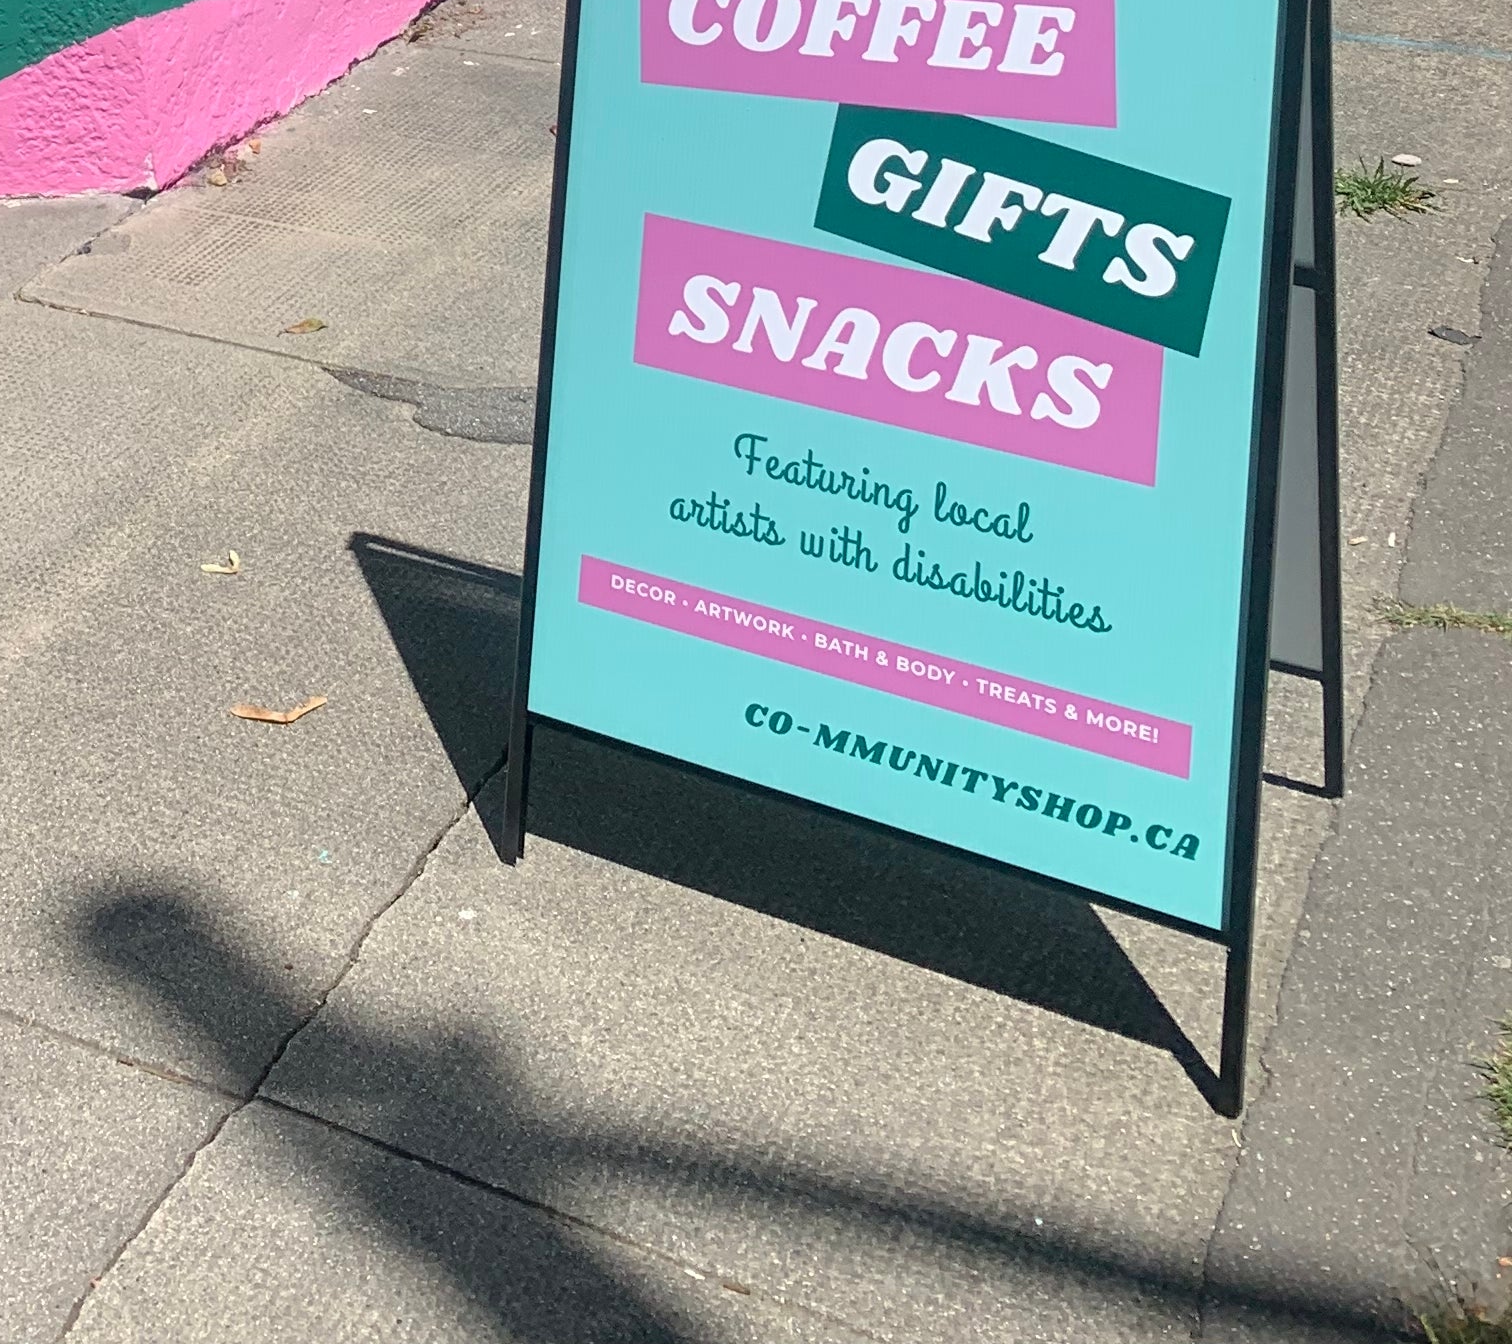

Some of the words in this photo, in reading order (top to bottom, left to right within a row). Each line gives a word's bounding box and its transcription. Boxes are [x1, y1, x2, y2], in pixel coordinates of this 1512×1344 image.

[846, 137, 1196, 300] GIFTS
[667, 273, 1115, 431] SNACKS
[669, 490, 786, 546] artists
[799, 525, 879, 573] with
[892, 541, 1113, 634] disabilities
[733, 432, 920, 534] Featuring
[934, 481, 1035, 544] local
[611, 573, 677, 607] DECOR
[694, 598, 795, 641] ARTWORK
[814, 632, 869, 662] BATH
[875, 649, 889, 667] &
[895, 654, 957, 686] BODY
[975, 677, 1058, 715] TREATS
[1063, 702, 1079, 721] &
[1085, 708, 1161, 745] MORE!
[744, 702, 1202, 862] CO-MMUNITYSHOP.CA
